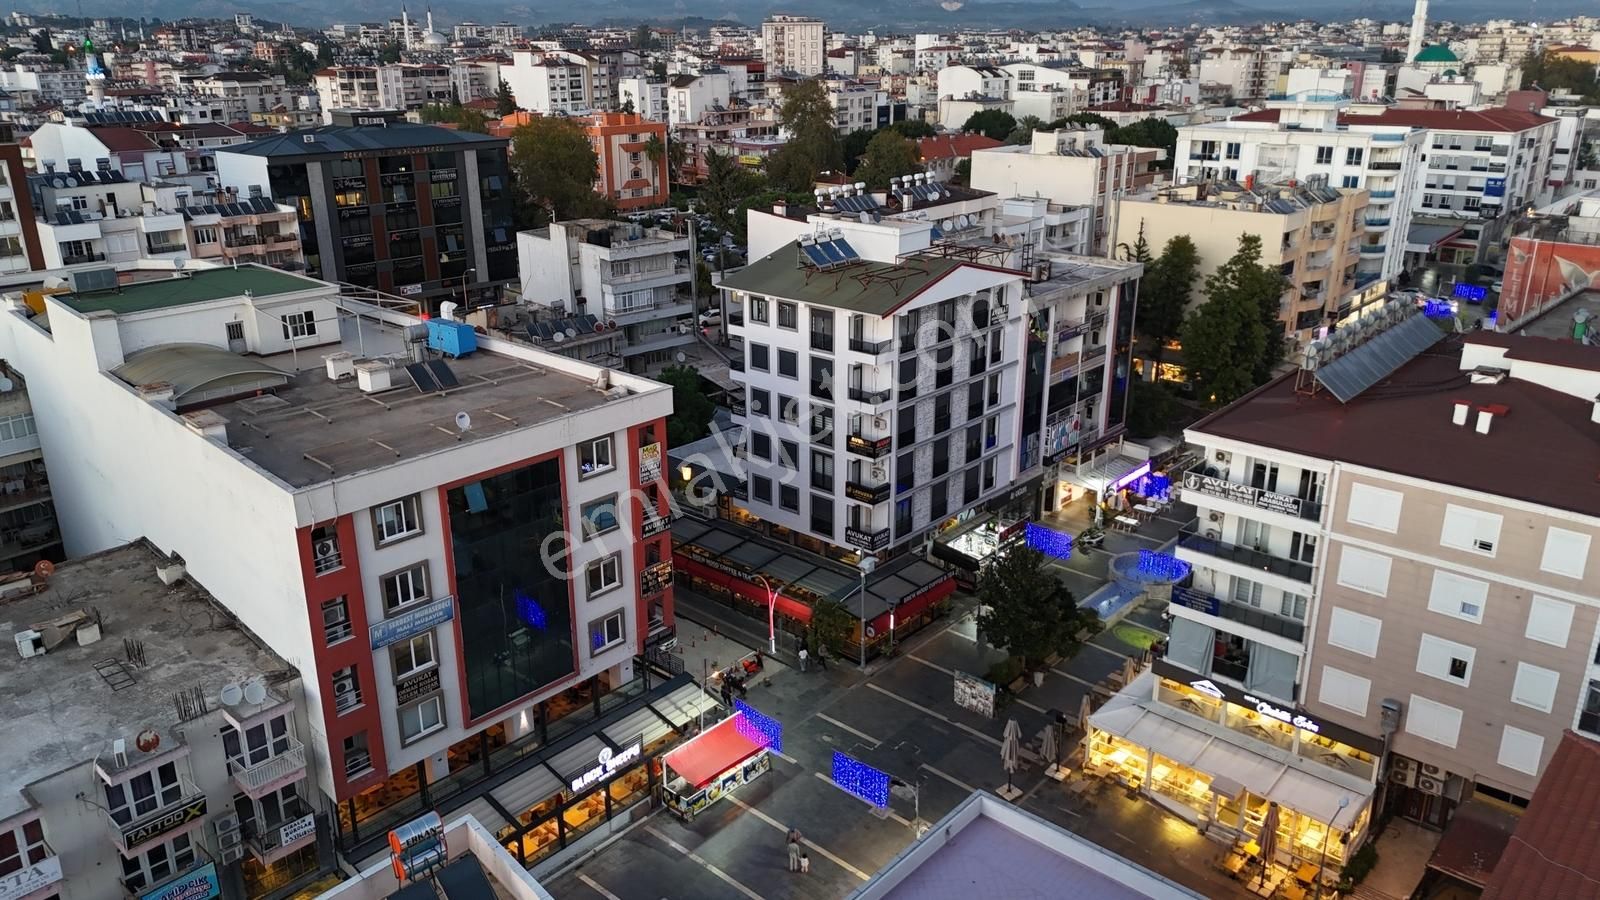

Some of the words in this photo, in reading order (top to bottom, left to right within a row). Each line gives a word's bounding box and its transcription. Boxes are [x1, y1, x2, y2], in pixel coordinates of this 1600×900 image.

[1202, 477, 1255, 495] AVUKAT
[1259, 496, 1298, 511] ARABULUCU
[1263, 492, 1293, 504] AVUKAT
[847, 529, 872, 542] AVUKAT
[403, 672, 432, 688] AVUKAT
[405, 826, 439, 848] ERKAN
